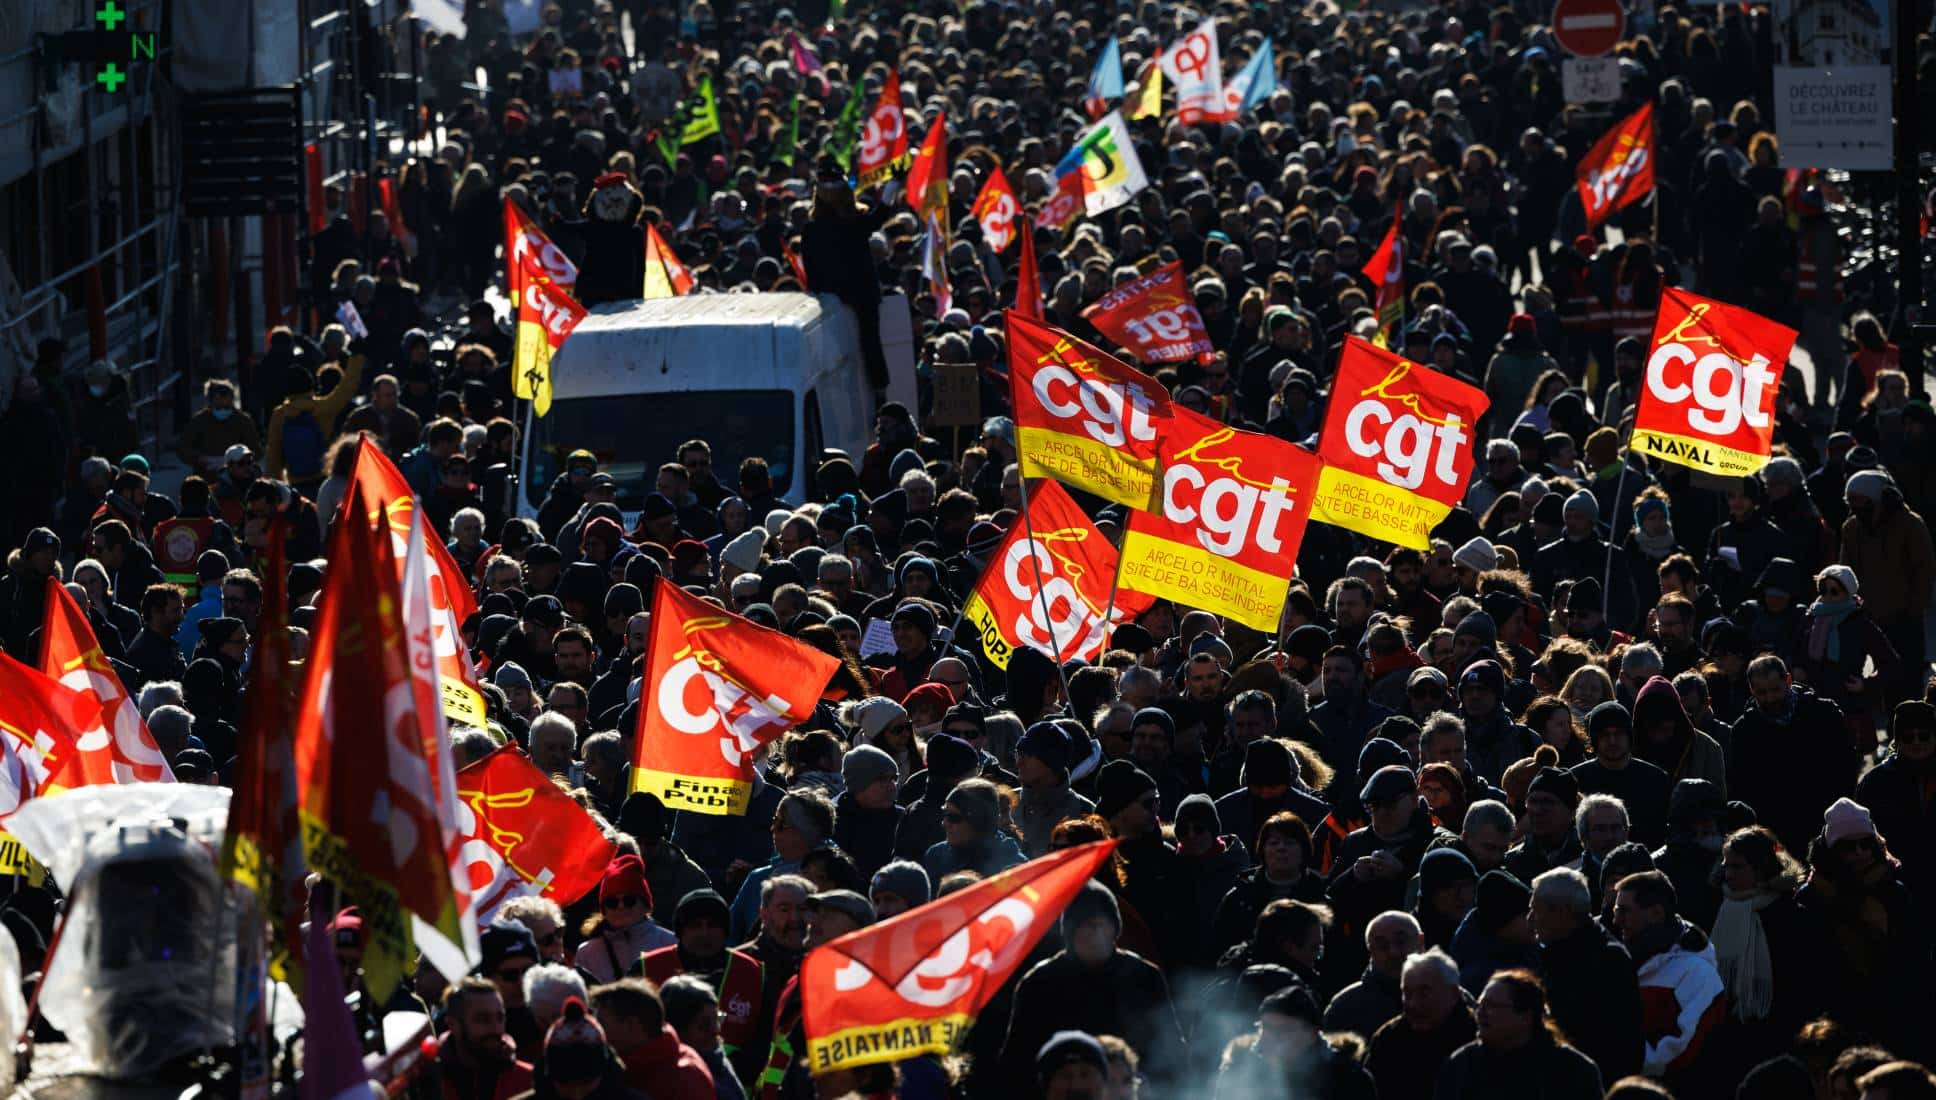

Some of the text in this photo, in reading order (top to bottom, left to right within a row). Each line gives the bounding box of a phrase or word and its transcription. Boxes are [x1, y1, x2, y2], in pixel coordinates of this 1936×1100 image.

[132, 33, 154, 59] N
[1789, 81, 1877, 98] DÉCOUVREZ
[1790, 99, 1878, 115] LE CHÂTEAU
[1647, 342, 1776, 435] cgt
[1032, 365, 1158, 447] cgt
[1045, 440, 1107, 469] ARCELOR
[1345, 399, 1468, 490] cgt
[1648, 435, 1714, 466] NAVAL
[1027, 451, 1057, 469] SITE
[1060, 458, 1079, 475] DE
[1164, 463, 1295, 557] cgt
[1313, 494, 1341, 512] SITE
[1343, 501, 1360, 518] DE
[1333, 481, 1395, 511] ARCELOR
[1153, 566, 1176, 584] DE
[1220, 569, 1265, 599] MITTAL
[1004, 538, 1125, 664] cgt
